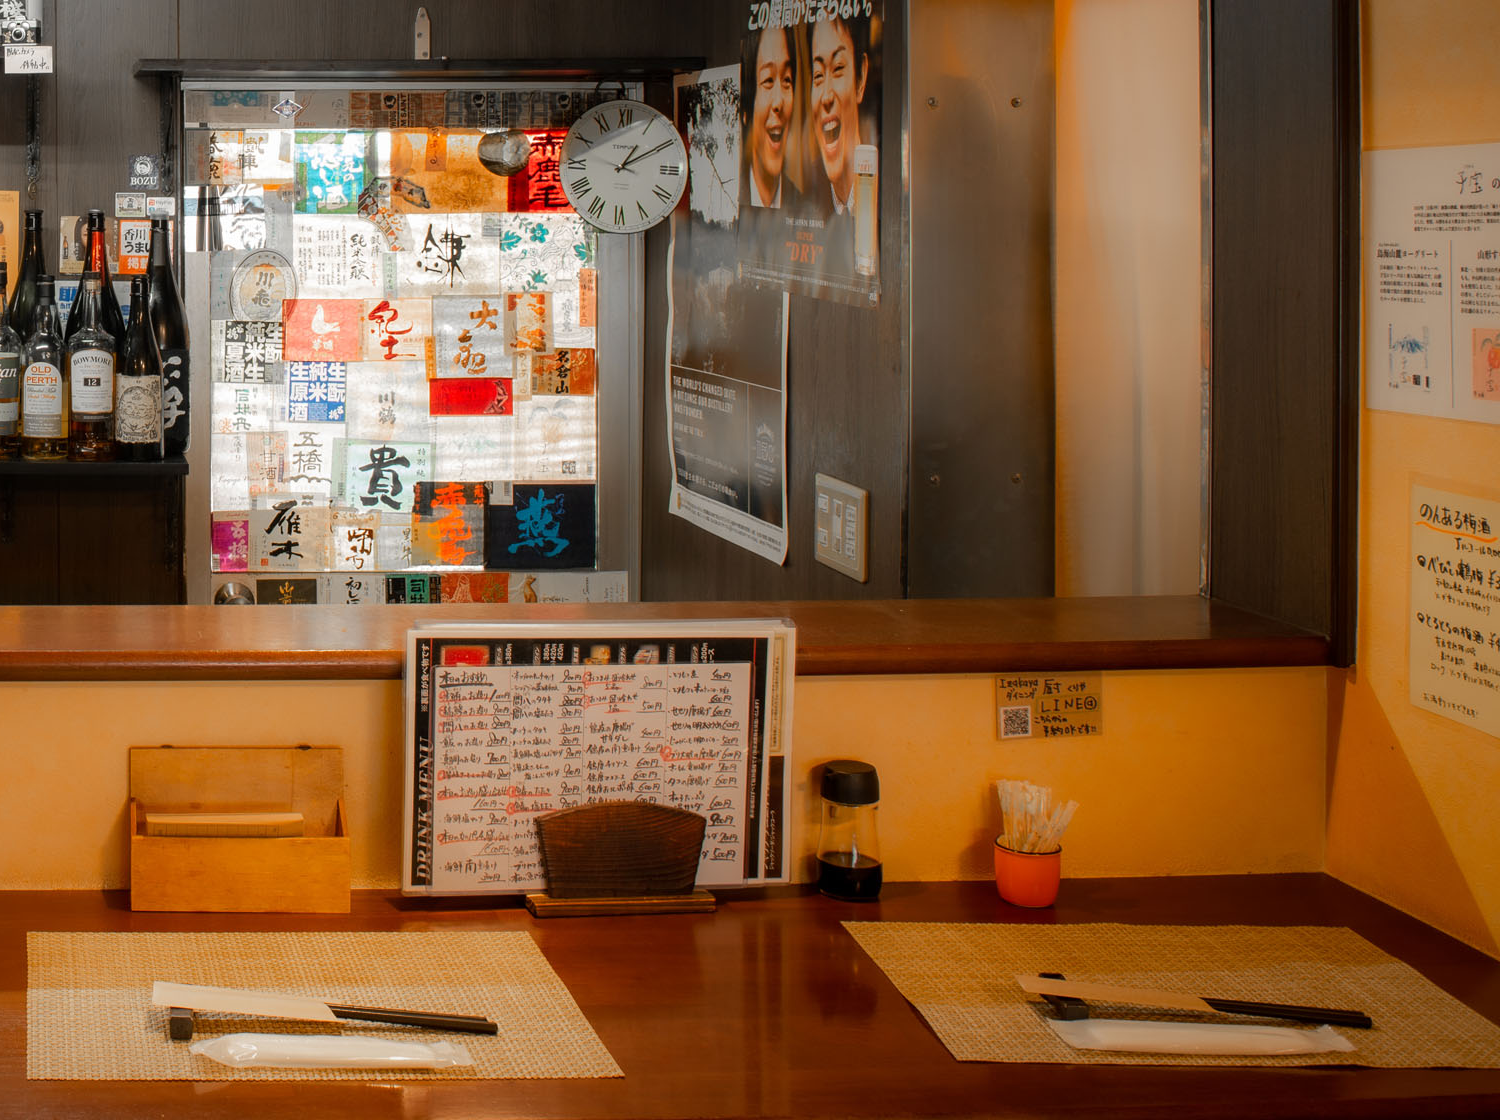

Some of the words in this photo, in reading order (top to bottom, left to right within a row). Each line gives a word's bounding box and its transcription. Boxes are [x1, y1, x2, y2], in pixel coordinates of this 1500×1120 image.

[129, 176, 158, 186] BOZU
[123, 227, 146, 241] 香川
[368, 300, 416, 360] 紀土
[30, 365, 52, 374] OLD
[72, 355, 113, 367] BOWMORE
[225, 342, 244, 382] 夏酒
[244, 320, 265, 383] 純米生
[26, 376, 58, 385] PERTH
[87, 377, 97, 386] 12
[289, 362, 309, 422] 生原酒
[309, 362, 328, 402] 純米
[555, 350, 571, 395] 名倉山
[293, 431, 324, 473] 五橋
[358, 444, 411, 510] 貴
[264, 499, 304, 560] 雁木
[1040, 695, 1098, 713] LINE@
[418, 736, 431, 804] MENU
[416, 807, 430, 882] DRINK
